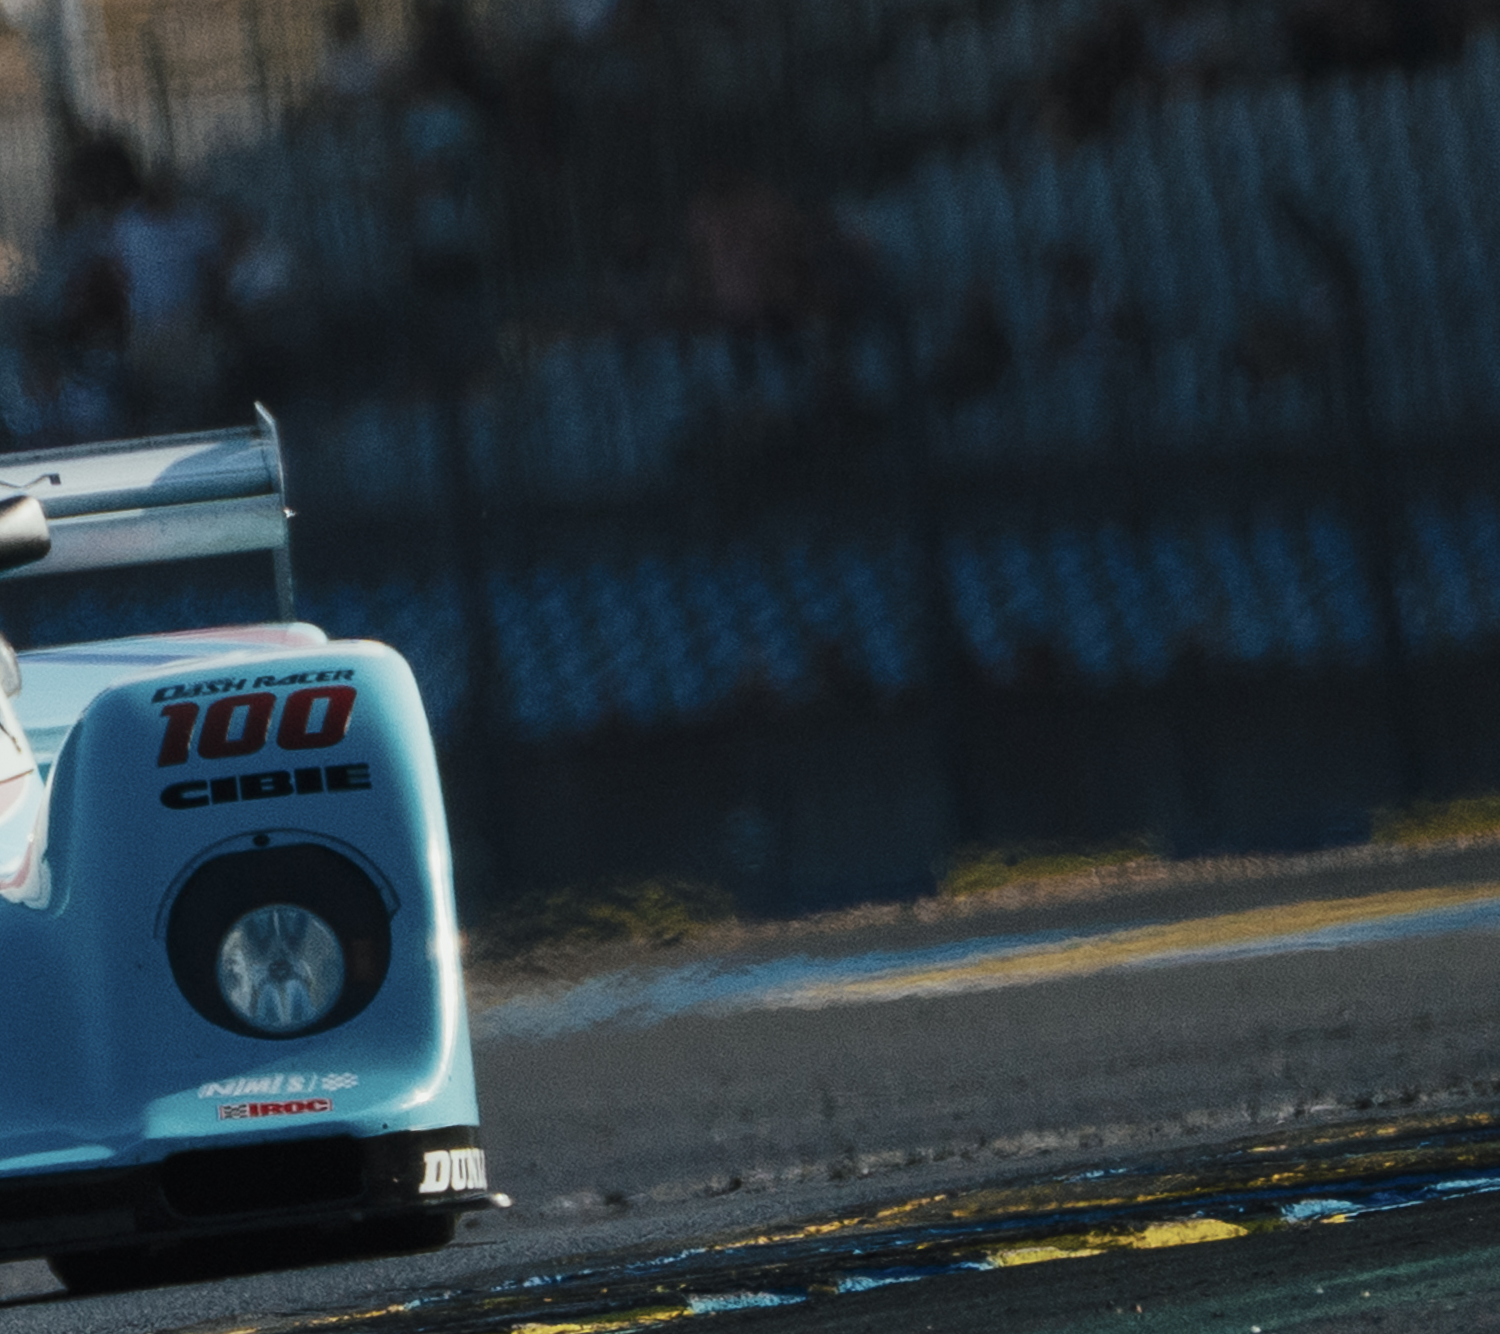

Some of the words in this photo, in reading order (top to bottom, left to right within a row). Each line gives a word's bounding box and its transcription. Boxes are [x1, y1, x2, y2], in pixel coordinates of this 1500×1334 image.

[252, 669, 355, 689] RACER
[157, 685, 358, 768] 100
[419, 1147, 488, 1194] DUN
